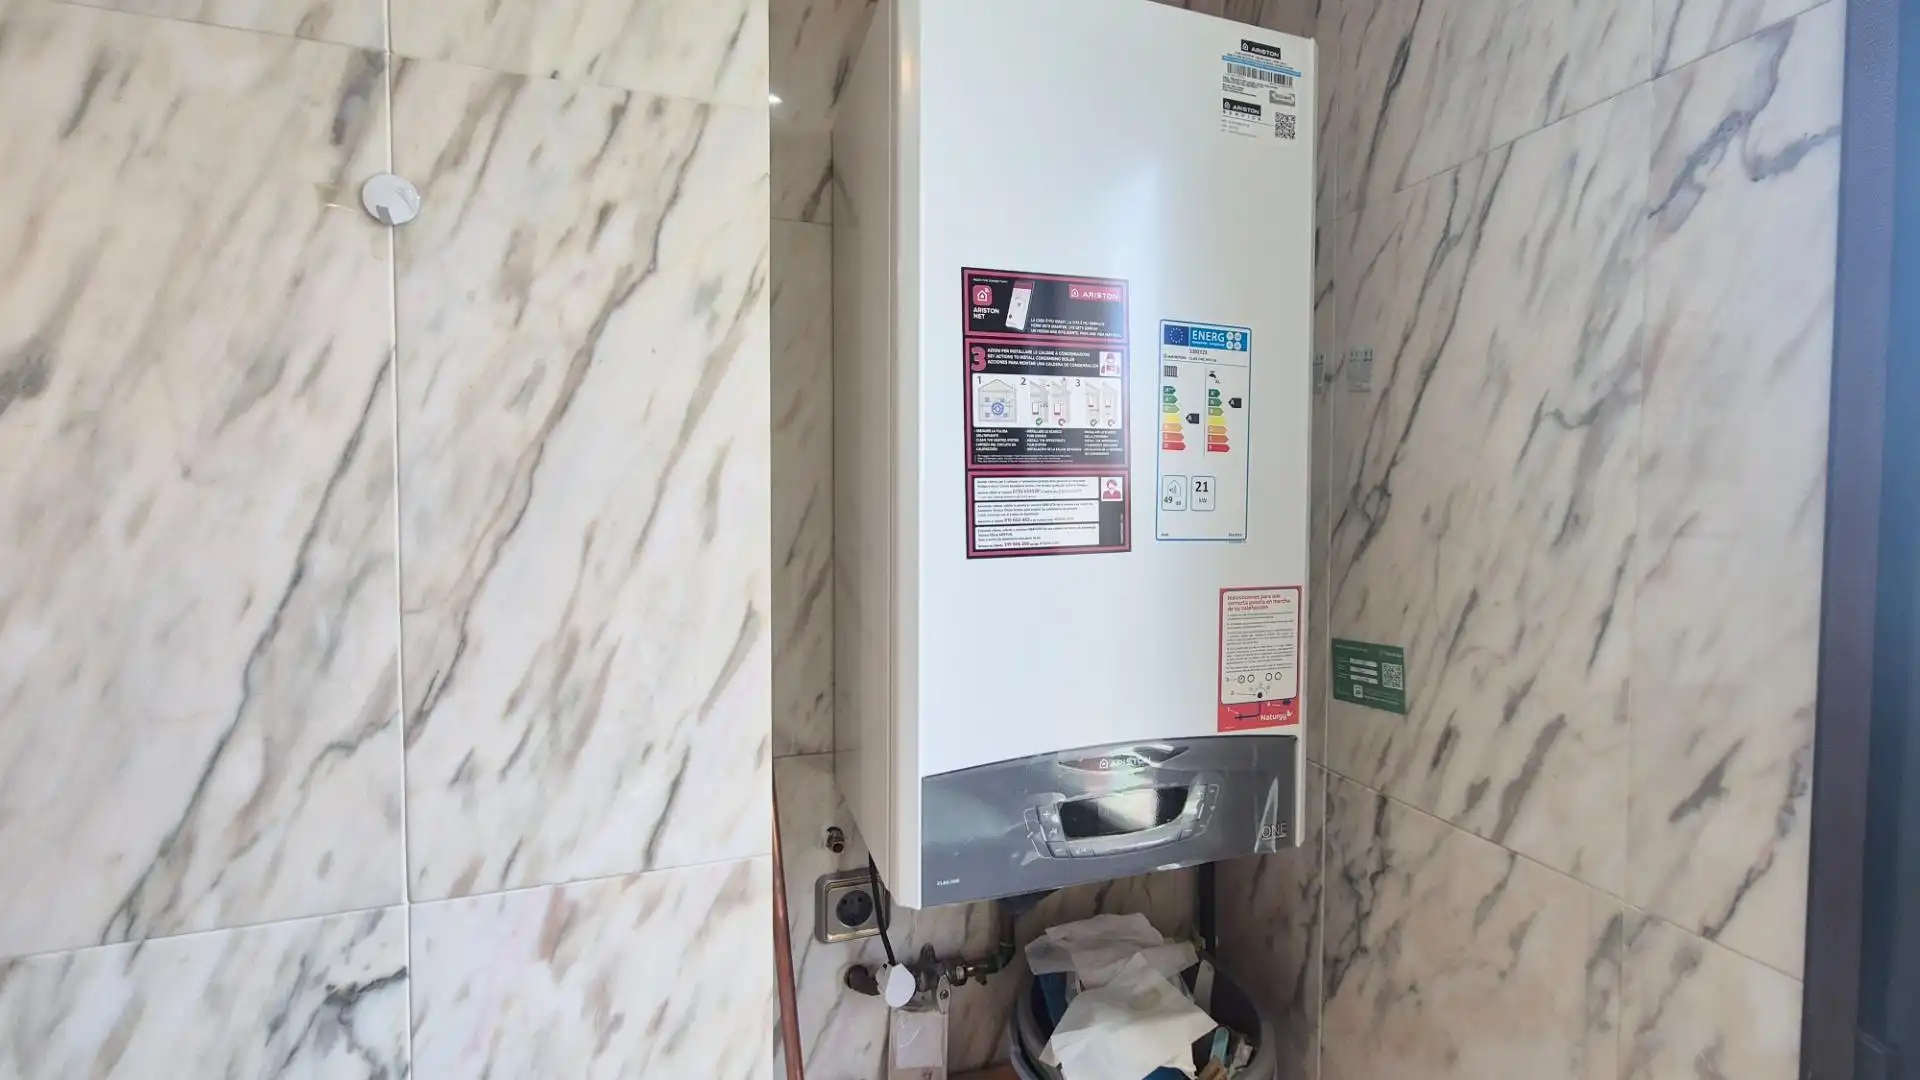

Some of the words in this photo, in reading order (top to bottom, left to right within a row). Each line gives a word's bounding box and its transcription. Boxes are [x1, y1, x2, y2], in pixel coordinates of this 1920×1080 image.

[1251, 47, 1280, 57] ARISTON
[1232, 105, 1260, 114] ARISTON
[1082, 291, 1120, 300] ARISTON
[1192, 329, 1225, 342] ENERG
[971, 347, 987, 371] 3
[977, 376, 981, 384] 1
[1021, 377, 1027, 386] 2
[1076, 379, 1081, 387] 3
[1195, 481, 1209, 493] 21
[1163, 496, 1173, 504] 49
[1198, 496, 1208, 504] kW
[1261, 713, 1287, 721] Naturgy
[1262, 822, 1287, 838] ONE
